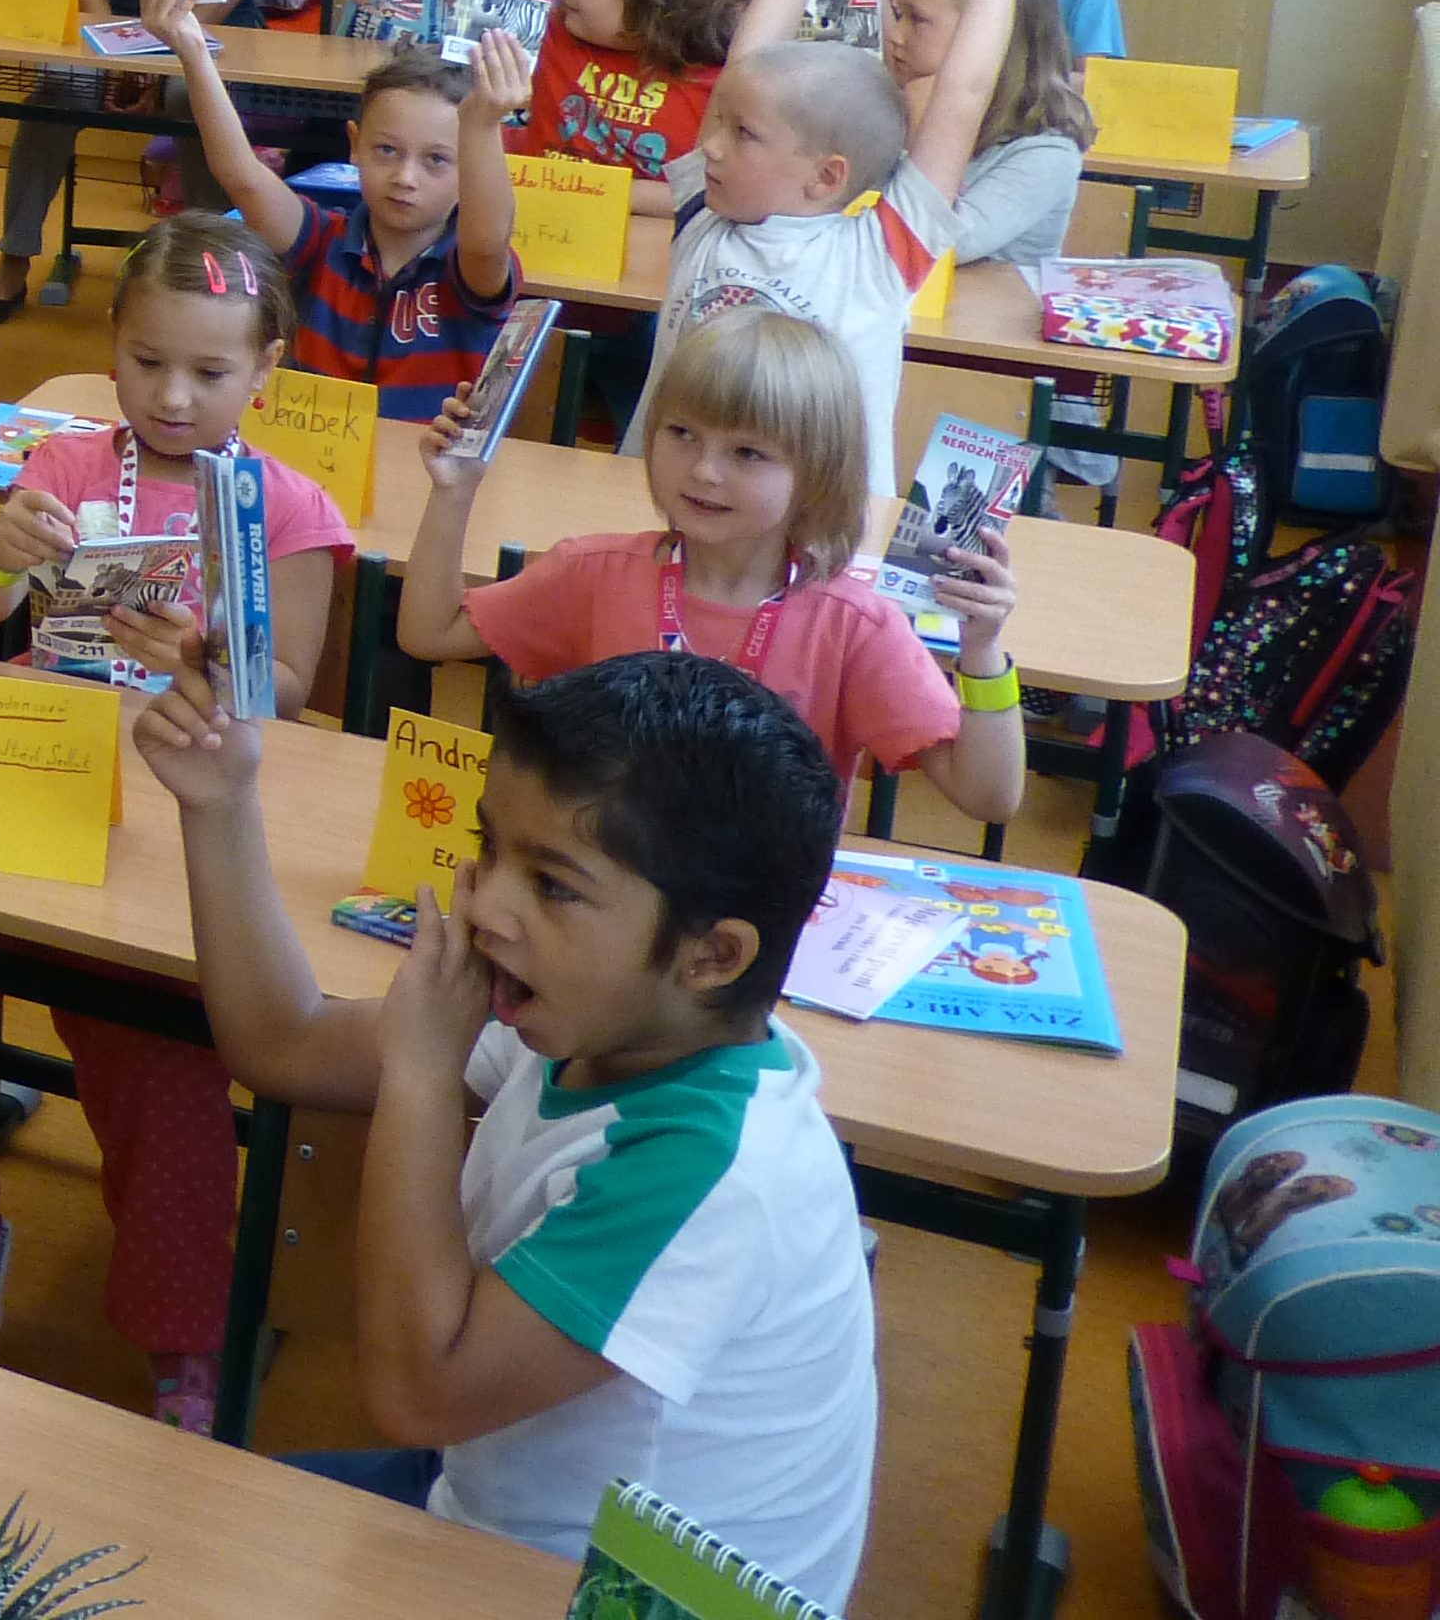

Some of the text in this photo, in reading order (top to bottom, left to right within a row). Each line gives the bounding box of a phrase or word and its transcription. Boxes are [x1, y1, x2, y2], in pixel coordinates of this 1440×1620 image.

[577, 62, 668, 109] KIDS
[249, 522, 267, 613] ROZVRH
[663, 576, 677, 620] CZECH
[77, 644, 105, 656] 211
[746, 612, 774, 657] CZECH
[396, 719, 489, 775] Andre
